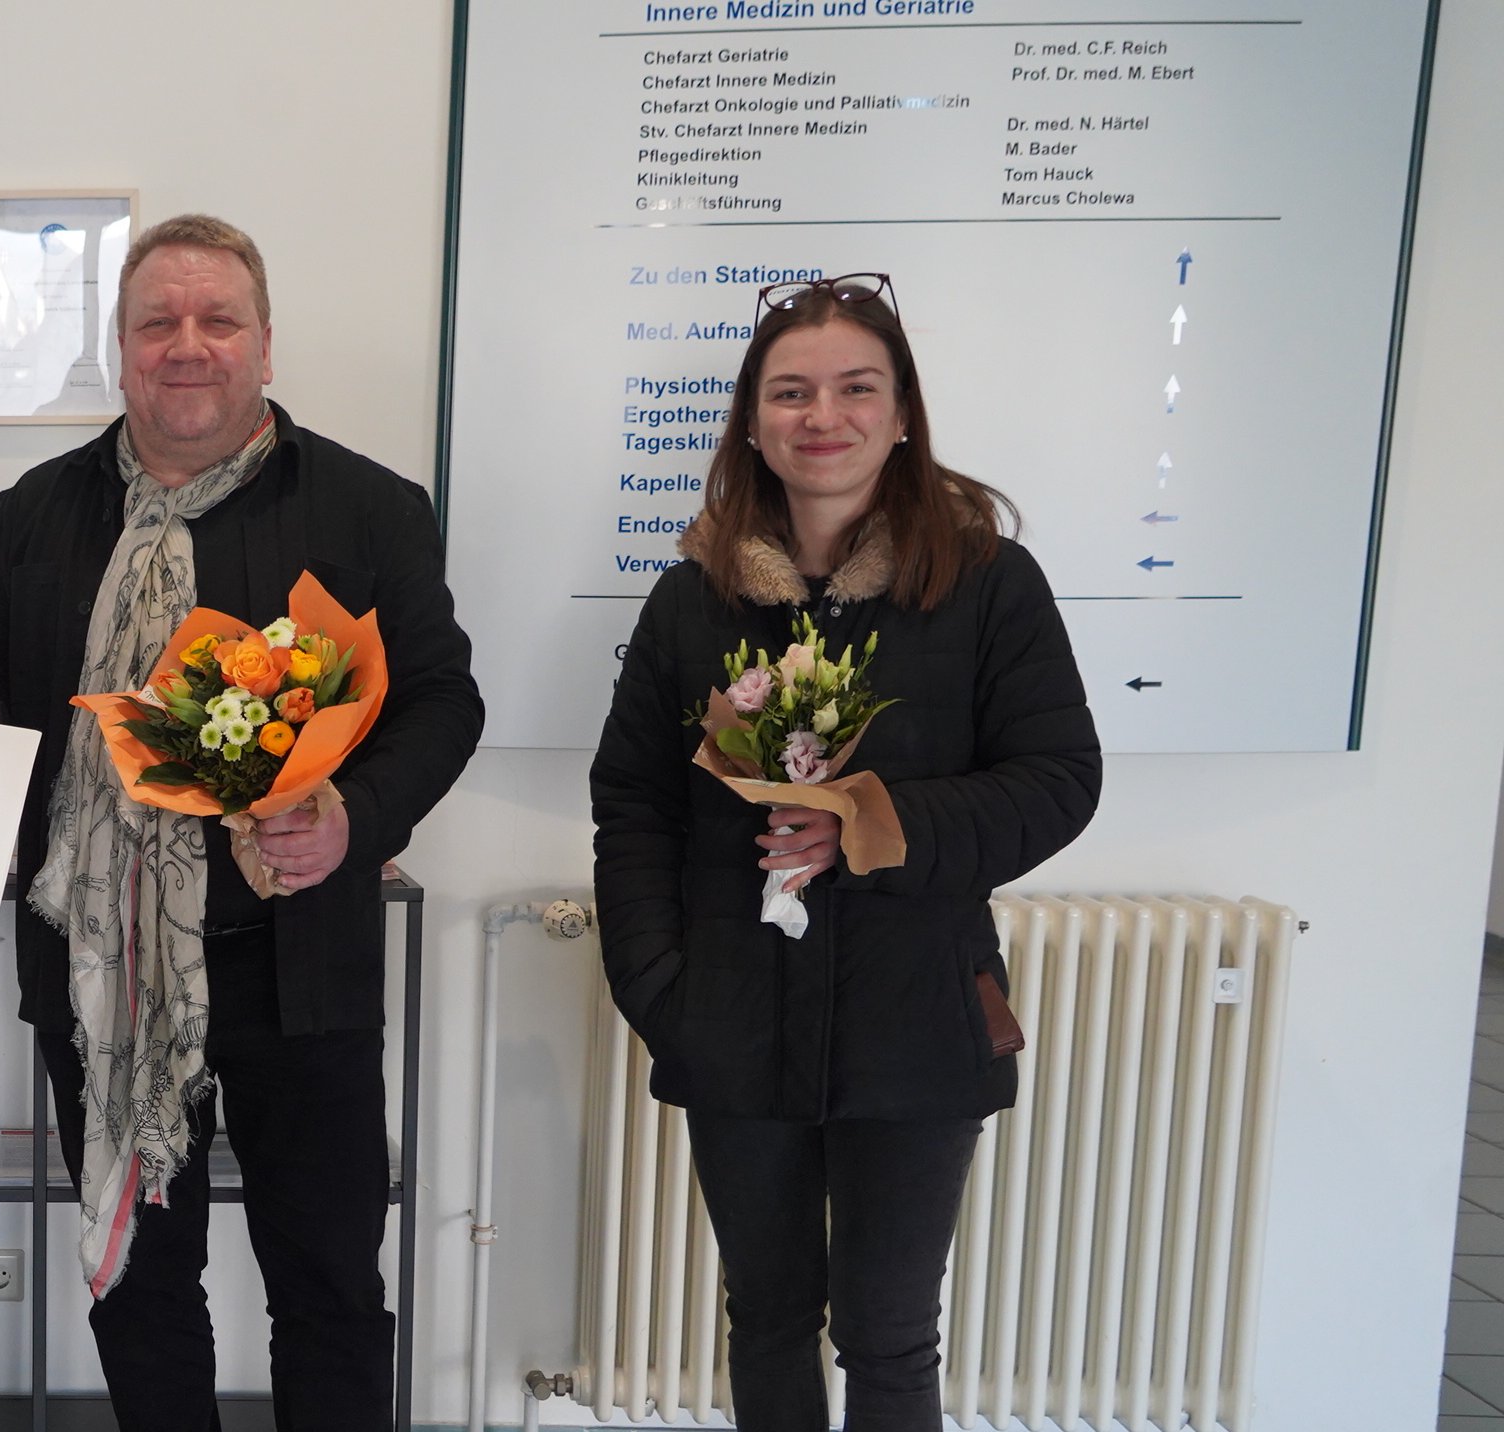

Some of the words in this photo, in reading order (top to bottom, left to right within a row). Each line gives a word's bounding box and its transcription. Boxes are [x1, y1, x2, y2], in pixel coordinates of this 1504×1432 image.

[647, 2, 718, 22] Innere
[726, 0, 814, 20] Medizin
[824, 0, 867, 17] und
[875, 0, 975, 17] Geriatrie
[643, 50, 712, 65] Chefarzt
[718, 47, 789, 63] Geriatrie
[1014, 42, 1036, 56] Dr.
[1042, 41, 1081, 56] med.
[1087, 41, 1116, 55] C.F.
[1122, 40, 1167, 55] Reich
[642, 75, 711, 90] Chefarzt
[716, 74, 767, 88] Innere
[773, 72, 836, 86] Medizin
[1011, 67, 1050, 81] Prof.
[1056, 66, 1078, 81] Dr.
[1083, 66, 1122, 80] med.
[1128, 66, 1145, 80] M.
[1151, 66, 1195, 80] Ebert
[641, 99, 709, 114] Chefarzt
[715, 97, 798, 114] Onkologie
[804, 96, 835, 111] und
[639, 125, 669, 138] Stv.
[674, 123, 743, 137] Chefarzt
[748, 122, 799, 136] Innere
[804, 120, 868, 135] Medizin
[1007, 118, 1029, 131] Dr.
[1034, 117, 1074, 131] med.
[1079, 117, 1096, 131] N.
[1101, 116, 1150, 130] Härtel
[638, 149, 762, 165] Pflegedirektion
[1005, 142, 1023, 156] M.
[1029, 142, 1078, 156] Bader
[637, 173, 739, 188] Klinikleitung
[1004, 168, 1037, 181] Tom
[1043, 167, 1094, 181] Hauck
[1001, 192, 1060, 205] Marcus
[1066, 191, 1135, 205] Cholewa
[629, 267, 658, 284] Zu
[666, 266, 707, 284] den
[715, 265, 823, 284] Stationen
[627, 322, 678, 340] Med.
[620, 474, 702, 495] Kapelle
